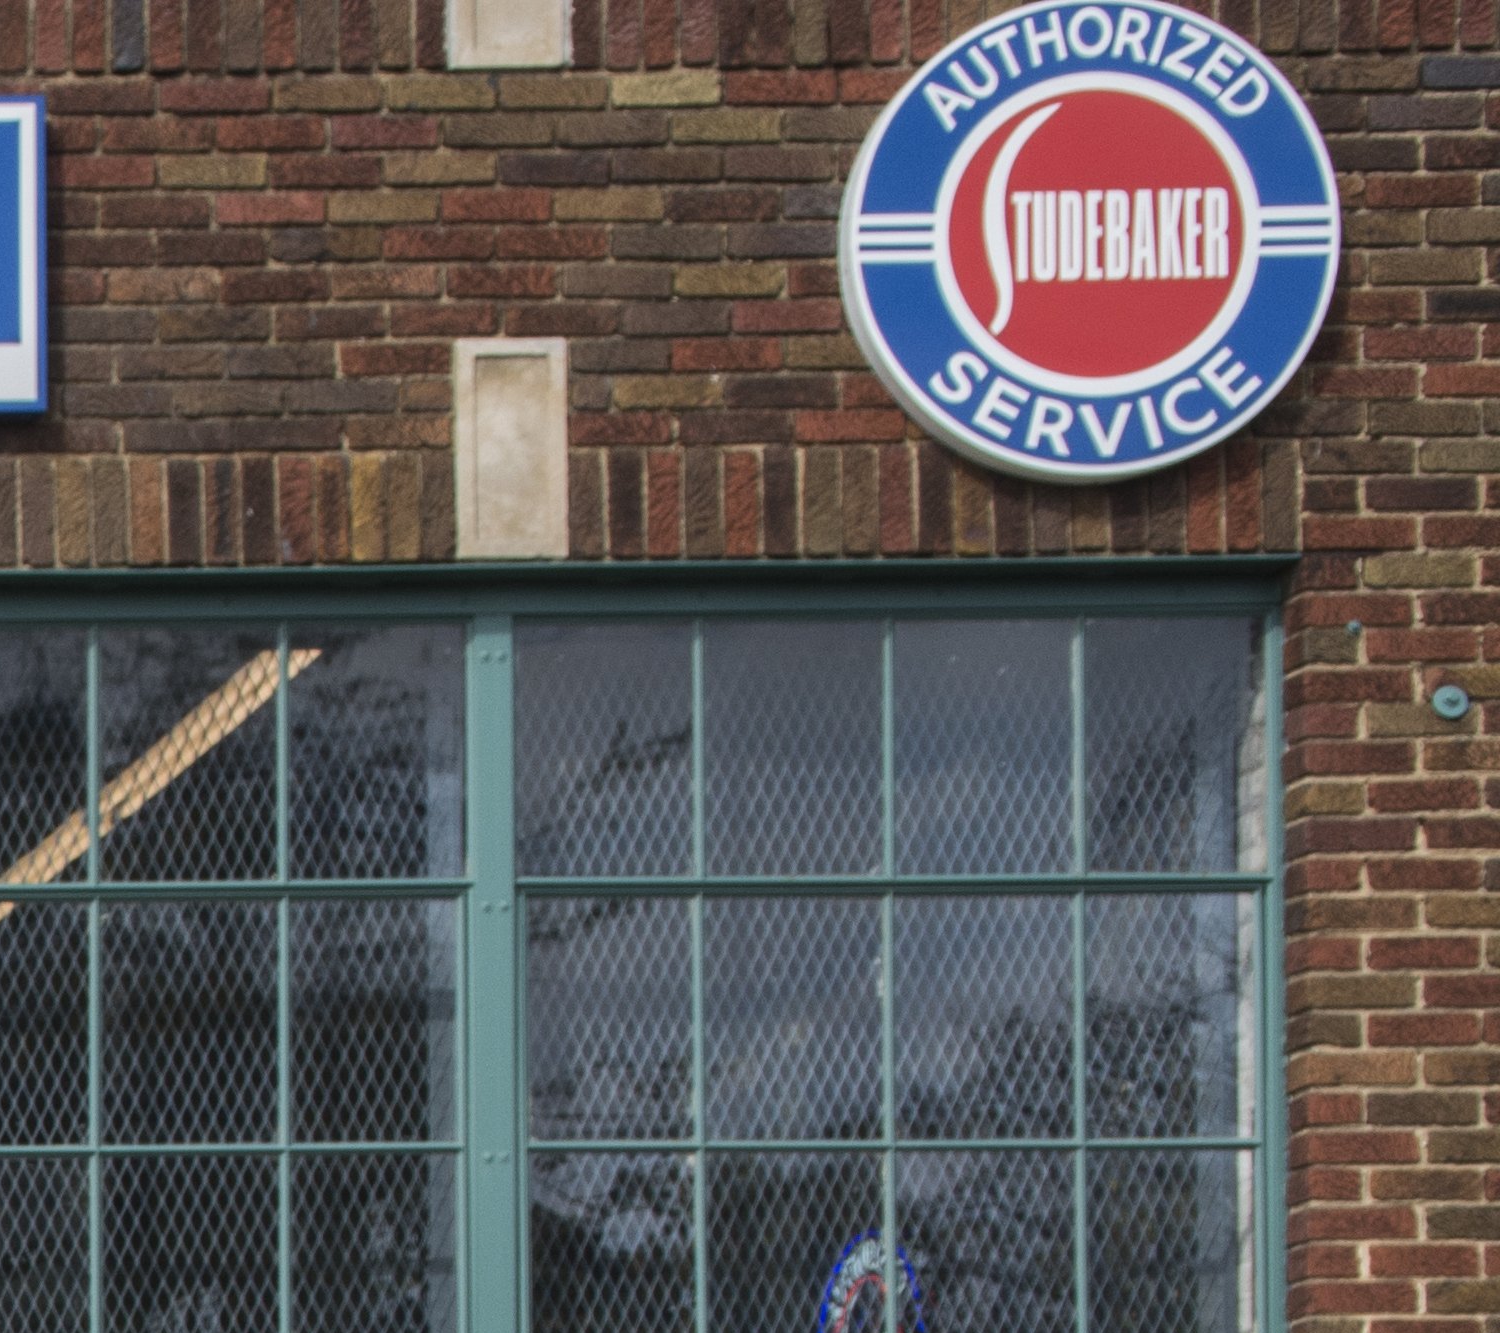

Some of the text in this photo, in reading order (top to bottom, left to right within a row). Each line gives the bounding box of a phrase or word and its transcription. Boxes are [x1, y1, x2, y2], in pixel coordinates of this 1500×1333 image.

[921, 6, 1270, 132] AUTHORIZED
[980, 101, 1231, 338] STUDEBAKER
[928, 346, 1263, 457] SERVICE
